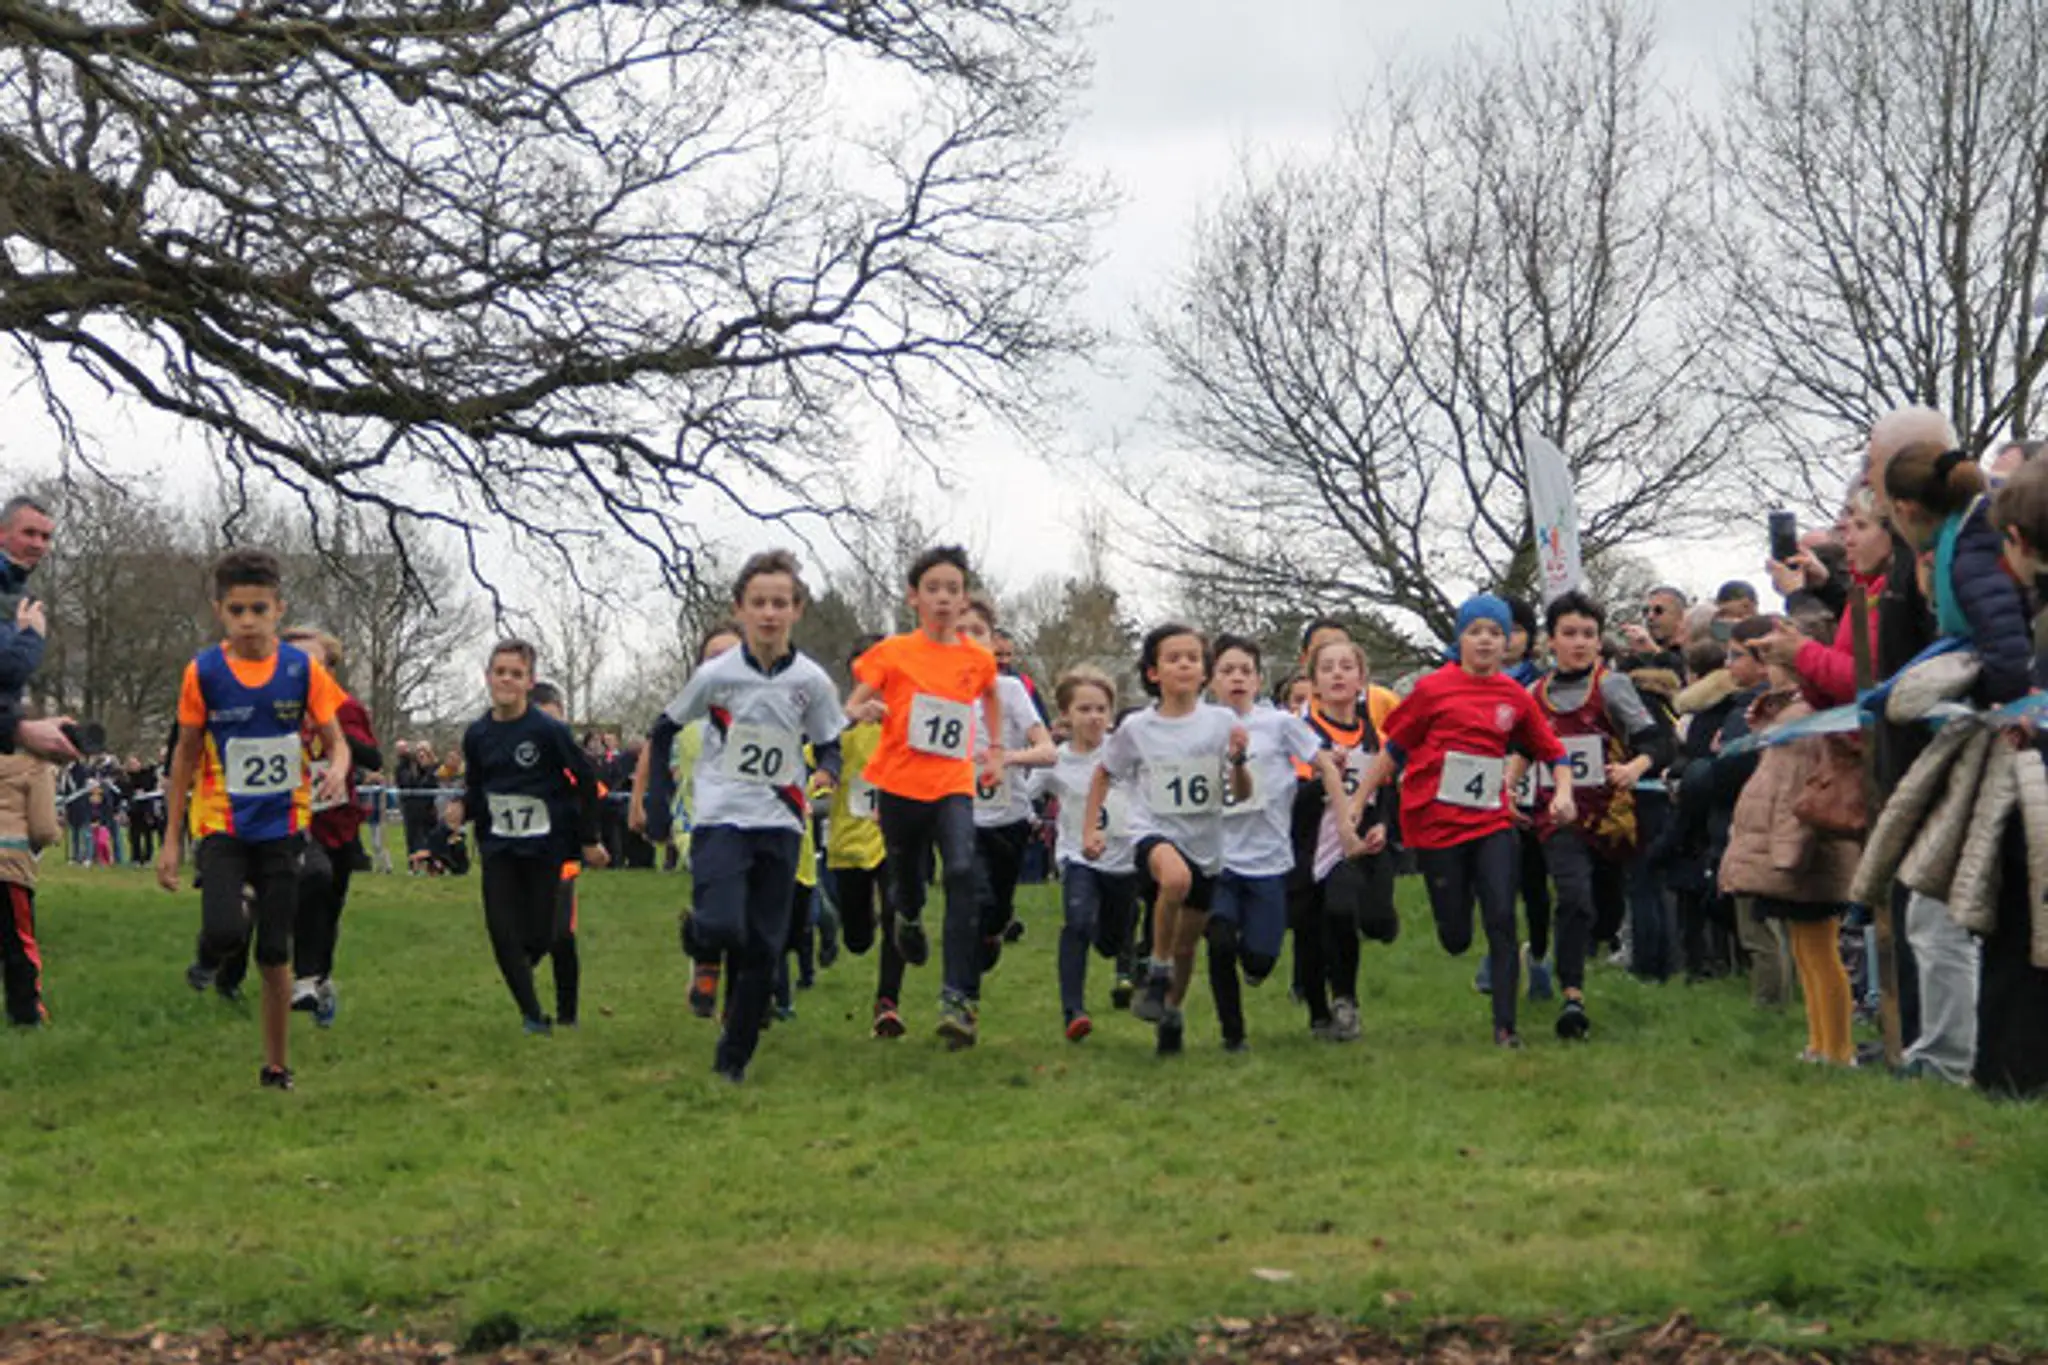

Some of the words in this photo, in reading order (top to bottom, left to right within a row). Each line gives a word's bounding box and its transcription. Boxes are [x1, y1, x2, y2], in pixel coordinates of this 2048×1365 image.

[925, 713, 964, 749] 18
[243, 754, 289, 787] 23
[737, 743, 784, 778] 20
[1166, 774, 1209, 806] 16
[1464, 772, 1485, 800] 4
[501, 806, 534, 831] 17
